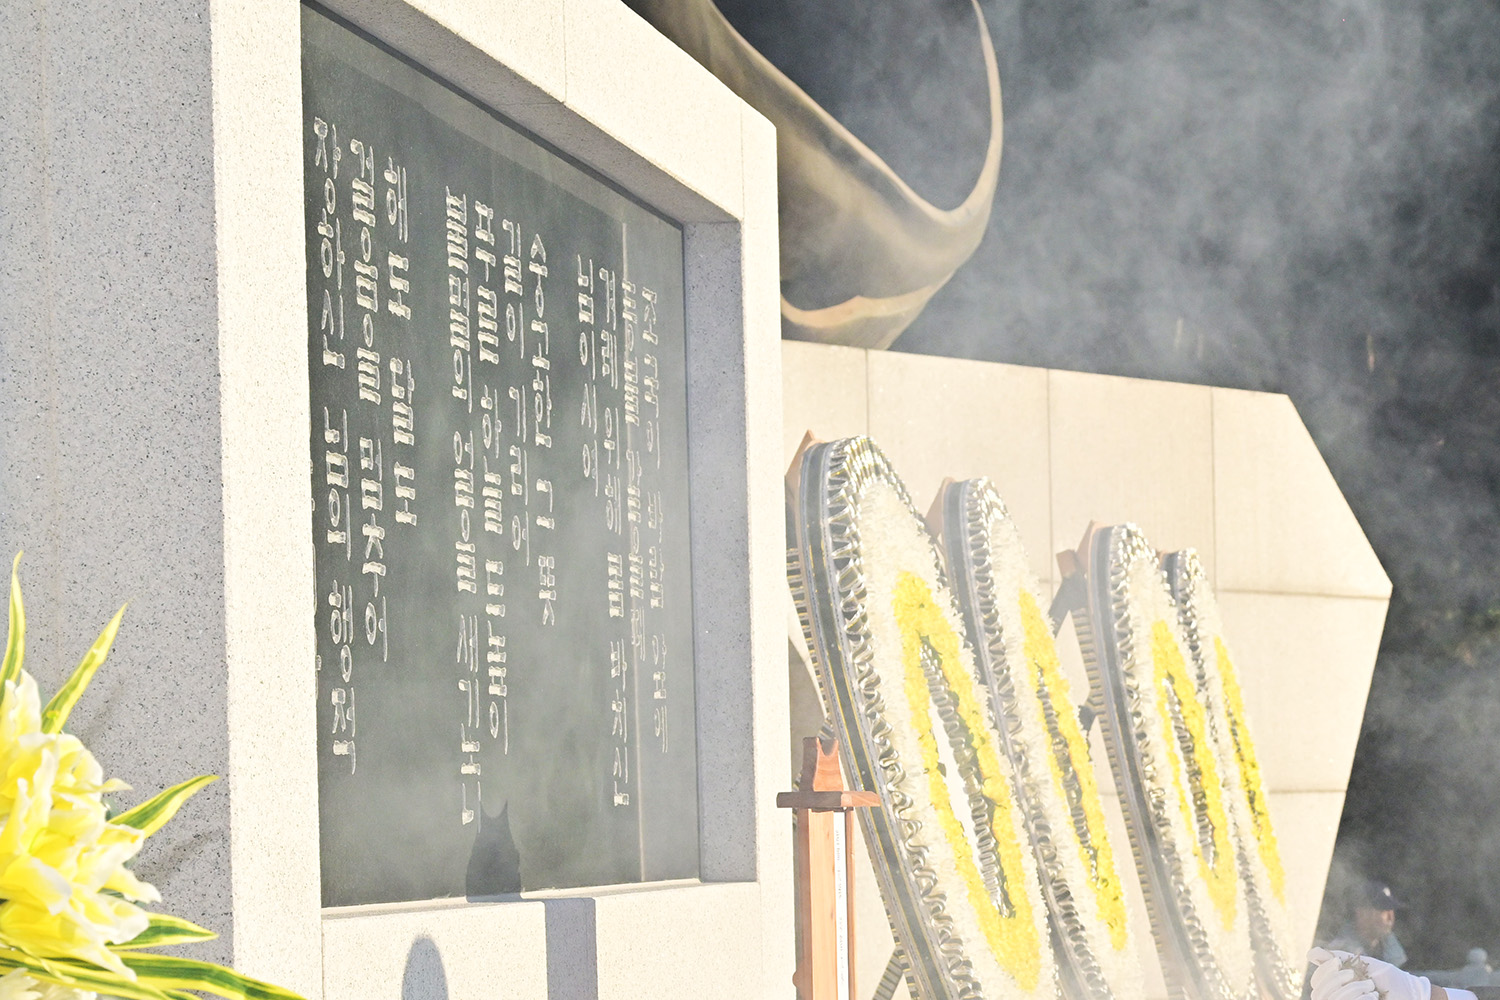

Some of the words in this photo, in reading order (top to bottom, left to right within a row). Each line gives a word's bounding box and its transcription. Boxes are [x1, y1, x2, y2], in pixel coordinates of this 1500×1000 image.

[313, 116, 346, 370] 장하신
[349, 138, 382, 406] 걸음을
[383, 155, 412, 321] 해도
[445, 185, 473, 414] 불멸의
[474, 200, 500, 365] 푸른
[501, 218, 525, 360] 길이
[528, 233, 553, 449] 숭고한
[574, 253, 599, 498] 님이시여
[598, 267, 619, 390] 겨레
[641, 286, 661, 470] 조국이
[323, 406, 352, 562] 님의
[389, 357, 418, 527] 달도
[453, 430, 477, 594] 얼을
[480, 384, 503, 535] 하늘
[508, 384, 530, 567] 기리어
[535, 478, 556, 530] 그
[603, 406, 622, 536] 위해
[359, 436, 389, 663] 멈추어
[537, 554, 557, 627] 뜻
[607, 551, 625, 618] 몸
[647, 493, 665, 609] 바람
[328, 579, 357, 776] 행적
[456, 613, 482, 834] 새기노니
[485, 558, 509, 756] 드높이
[609, 638, 630, 807] 바치신
[651, 633, 669, 754] 앞에
